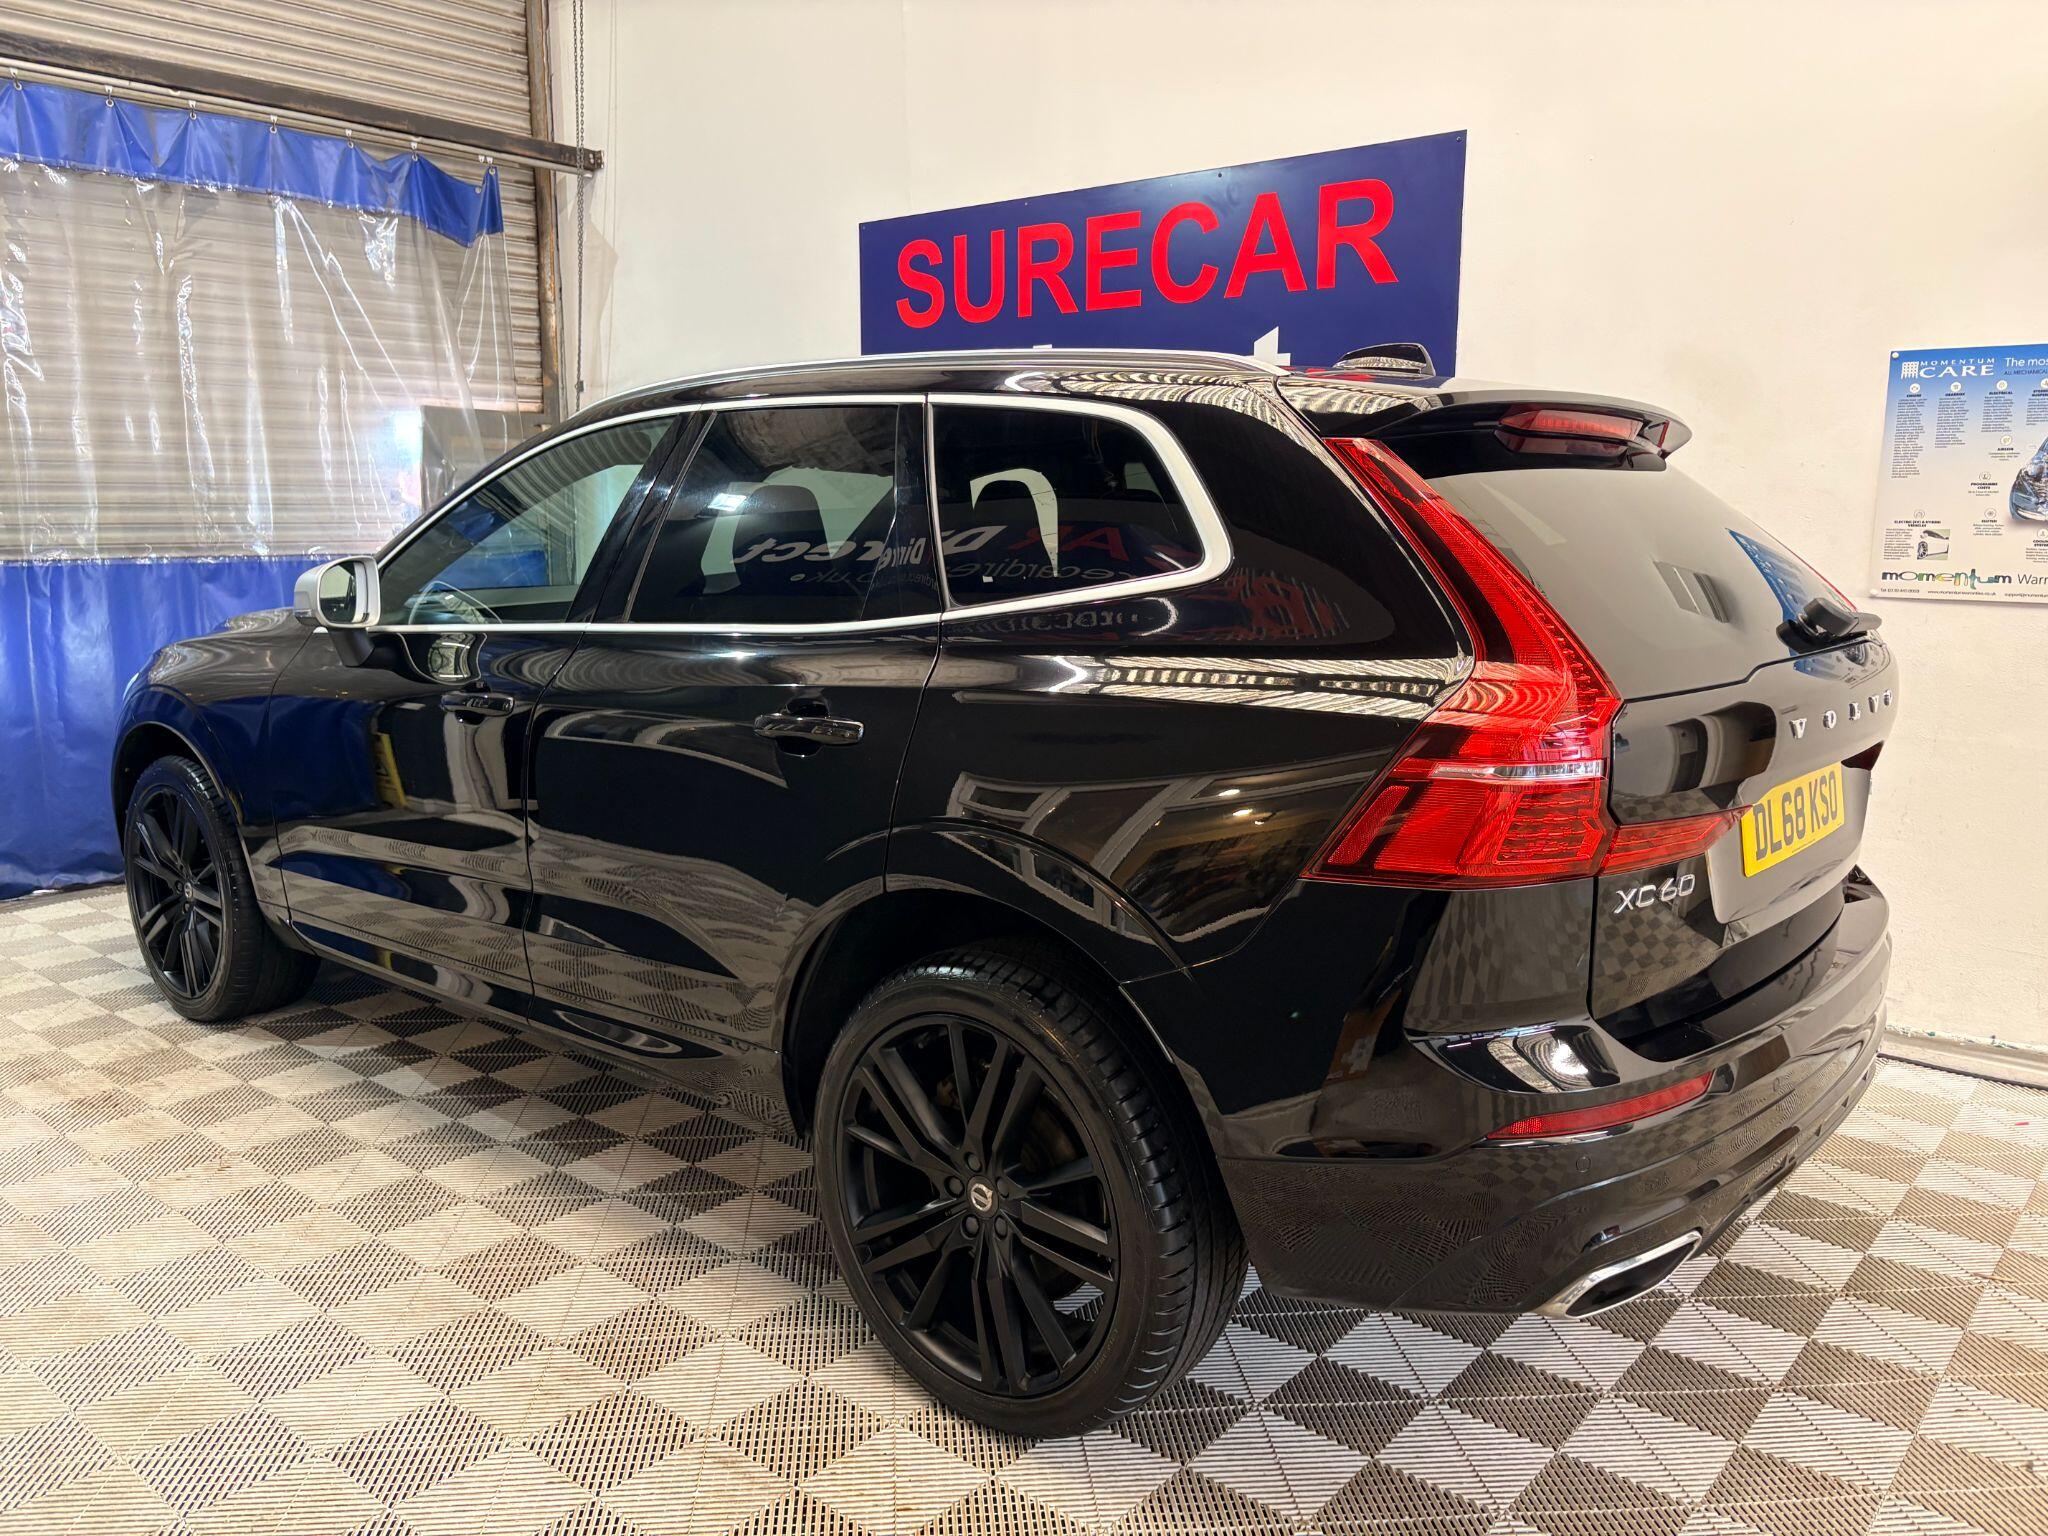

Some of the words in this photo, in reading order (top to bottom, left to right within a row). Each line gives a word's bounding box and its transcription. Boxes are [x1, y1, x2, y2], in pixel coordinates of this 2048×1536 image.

[896, 178, 1399, 328] SURECAR
[1920, 358, 1995, 366] MOMENTUM
[1920, 365, 1994, 379] CARE
[2004, 357, 2025, 367] The
[1881, 568, 2012, 590] momentum
[1789, 689, 1892, 740] VOLVO
[1753, 786, 1806, 860] DL68
[1809, 770, 1838, 834] KSO
[1613, 873, 1695, 914] XC60
